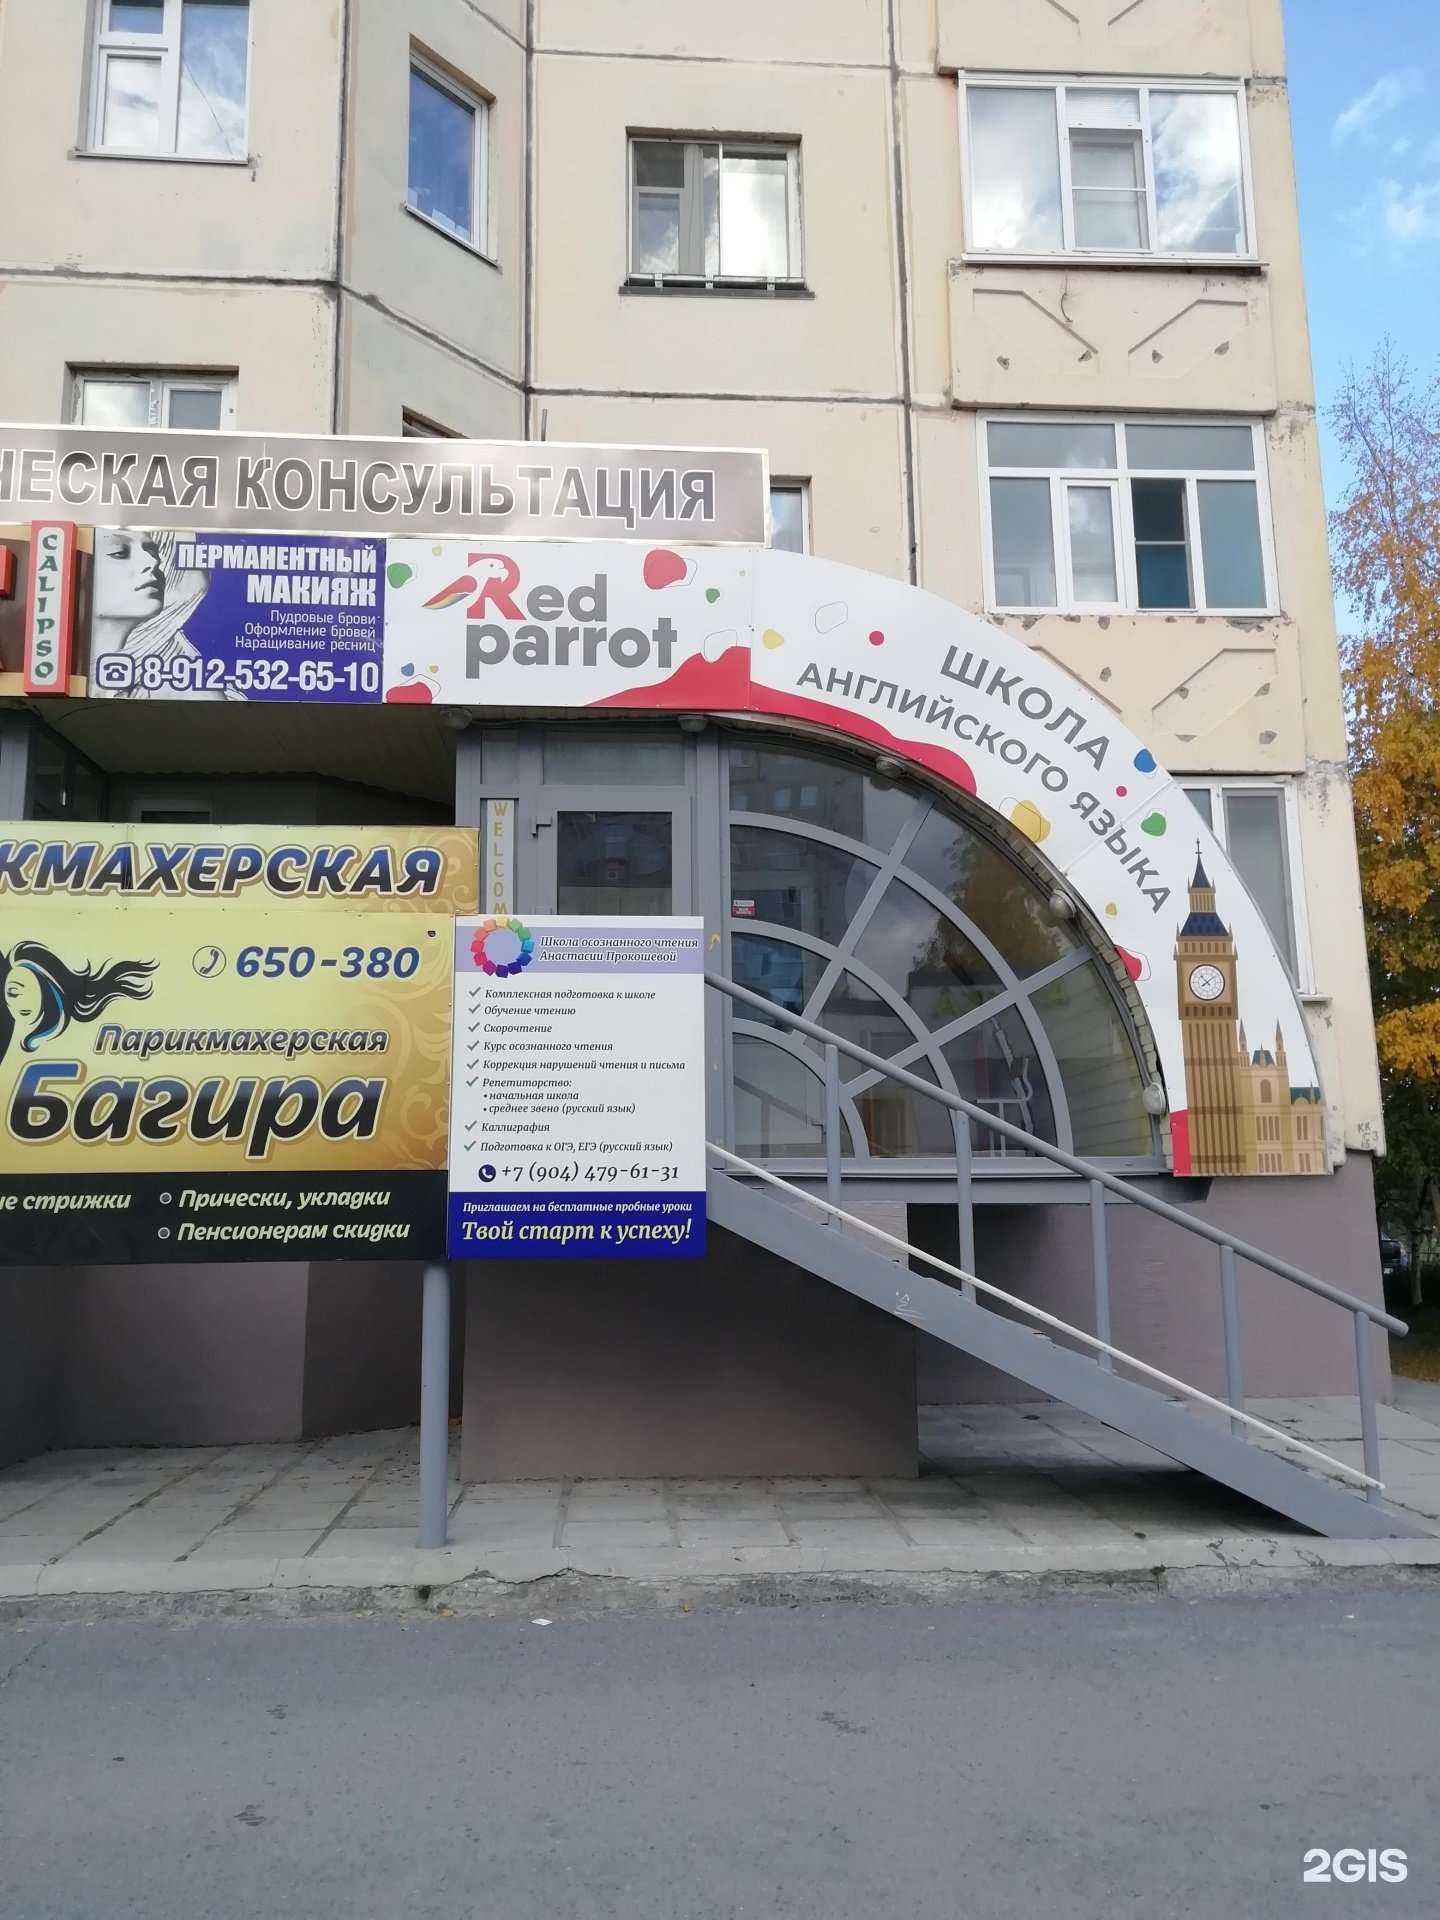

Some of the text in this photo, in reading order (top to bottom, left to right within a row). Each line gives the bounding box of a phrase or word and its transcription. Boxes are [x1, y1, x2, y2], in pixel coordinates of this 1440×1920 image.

[235, 456, 716, 530] КОНСУЛЬТАЦИЯ
[177, 544, 376, 573] ПЕРМАНЕНТНЫЙ
[247, 574, 376, 606] МАКИЯЖ
[466, 553, 607, 622] Red
[35, 534, 58, 679] CALIPSO
[270, 610, 375, 625] Пудровые брови
[245, 623, 375, 638] Оформление бровей
[235, 637, 375, 652] Наращивание ресниц
[466, 618, 677, 679] parrot
[142, 658, 379, 693] 8-912-532-65-10
[939, 645, 1110, 771] ШКОЛА
[797, 663, 1171, 913] АНГЛИЙСКОГО ЯЗЫКА
[0, 840, 446, 897] КМАХЕРСКАЯ
[540, 936, 698, 949] Школа осознанного чтения
[235, 945, 420, 979] 650-380
[540, 951, 677, 963] Анастасии Прокошевой
[485, 989, 656, 1001] Комплексная подготовка к школе
[484, 1005, 576, 1016] Обучение чтению
[484, 1023, 552, 1034] Скорочтение
[94, 1024, 389, 1060] Парикмахерская
[484, 1041, 613, 1053] Курс осознанного чтения
[483, 1059, 685, 1071] Коррекция нарушений чтения и письма
[482, 1078, 573, 1089] Репетиторство:
[489, 1091, 579, 1100] начальная школа
[7, 1059, 387, 1161] Багира
[489, 1103, 636, 1115] среднее звено (русский язык)
[481, 1122, 550, 1133] Каллиграфия
[480, 1141, 673, 1153] Подготовка к ОГЭ, ЕГЭ (русский язык)
[501, 1161, 680, 1183] +7 (904) 479-61-31
[22, 1193, 131, 1213] стрижки
[178, 1189, 390, 1211] Прически, укладки
[463, 1201, 693, 1214] Приглашаем на бесплатные пробные уроки
[178, 1222, 410, 1243] Пенсионерам скидки
[461, 1218, 693, 1245] Твой старт к успеху!
